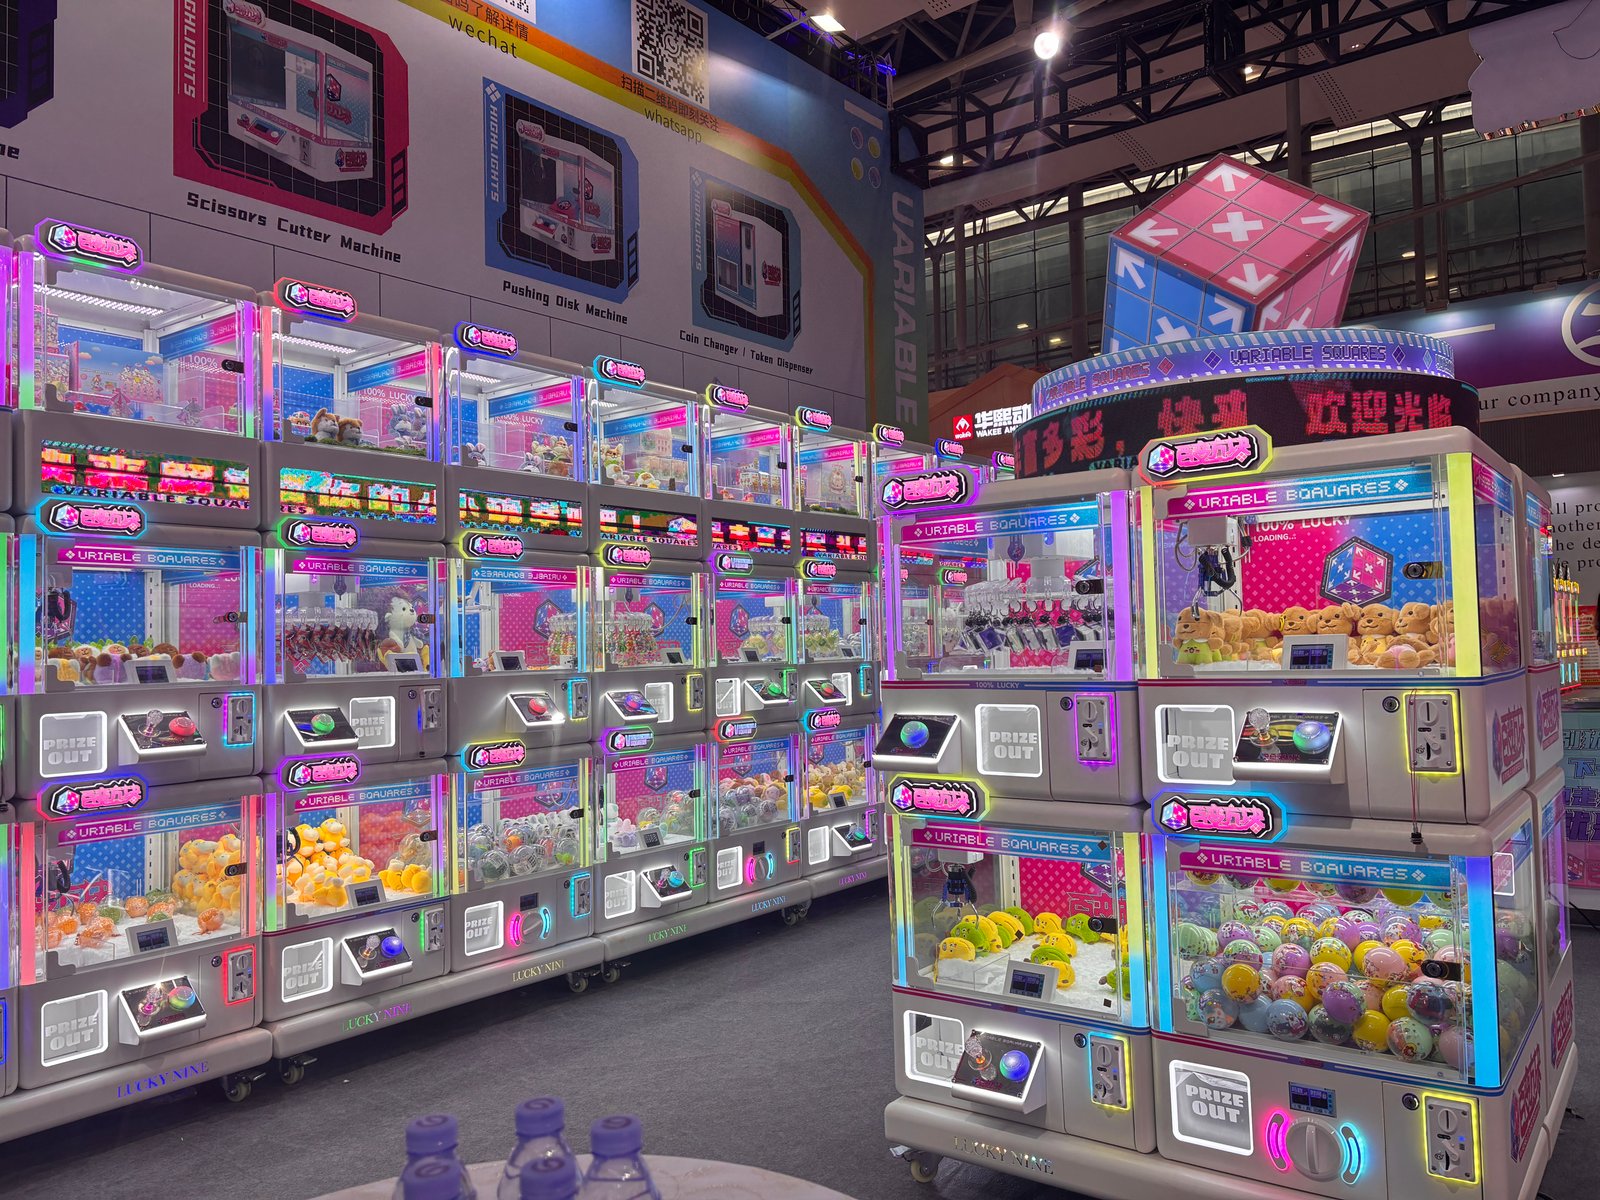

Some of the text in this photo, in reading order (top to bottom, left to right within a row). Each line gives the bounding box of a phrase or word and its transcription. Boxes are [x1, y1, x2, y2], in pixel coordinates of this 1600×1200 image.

[446, 0, 528, 41] 码了解详情
[449, 15, 517, 58] wechat
[621, 73, 720, 133] 扫描二维码即刻关注
[644, 107, 702, 144] whatsapp
[489, 105, 499, 202] HIGHLIGHTS
[186, 192, 401, 263] Scissors Cutter Machine
[503, 280, 628, 325] Pushing Disk Machine
[680, 330, 699, 344] Coin
[704, 335, 738, 355] Changer
[750, 350, 773, 365] Token
[777, 357, 813, 375] Dispenser
[1322, 345, 1386, 361] SQUARES
[189, 355, 218, 368] 100%
[363, 388, 415, 401] 100% LUCKY
[1508, 386, 1600, 407] company
[523, 416, 543, 425] LUCKY
[976, 428, 1002, 438] WAKEE
[64, 487, 175, 502] VARIABLE
[1550, 502, 1566, 515] ll
[1553, 539, 1574, 551] he
[975, 681, 1019, 689] 100% LUCKY
[351, 715, 385, 727] PRIZE
[355, 725, 383, 737] OUT
[990, 731, 1037, 745] PRIZE
[43, 736, 96, 751] PRIZE
[1167, 734, 1228, 751] PRIZE
[48, 750, 92, 764] OUT
[994, 745, 1034, 759] OUT
[1172, 751, 1224, 768] OUT
[466, 917, 493, 929] PRIZE
[466, 926, 490, 939] OUT
[284, 959, 323, 977] PRIZE
[513, 965, 545, 982] LUCKY
[285, 972, 319, 989] OUT
[45, 1014, 98, 1036] PRIZE
[50, 1028, 94, 1050] OUT
[117, 1060, 209, 1098] LUCKY NINE
[1185, 1085, 1244, 1108] PRIZE
[1192, 1101, 1240, 1123] OUT
[953, 1136, 1006, 1161] LUCKY
